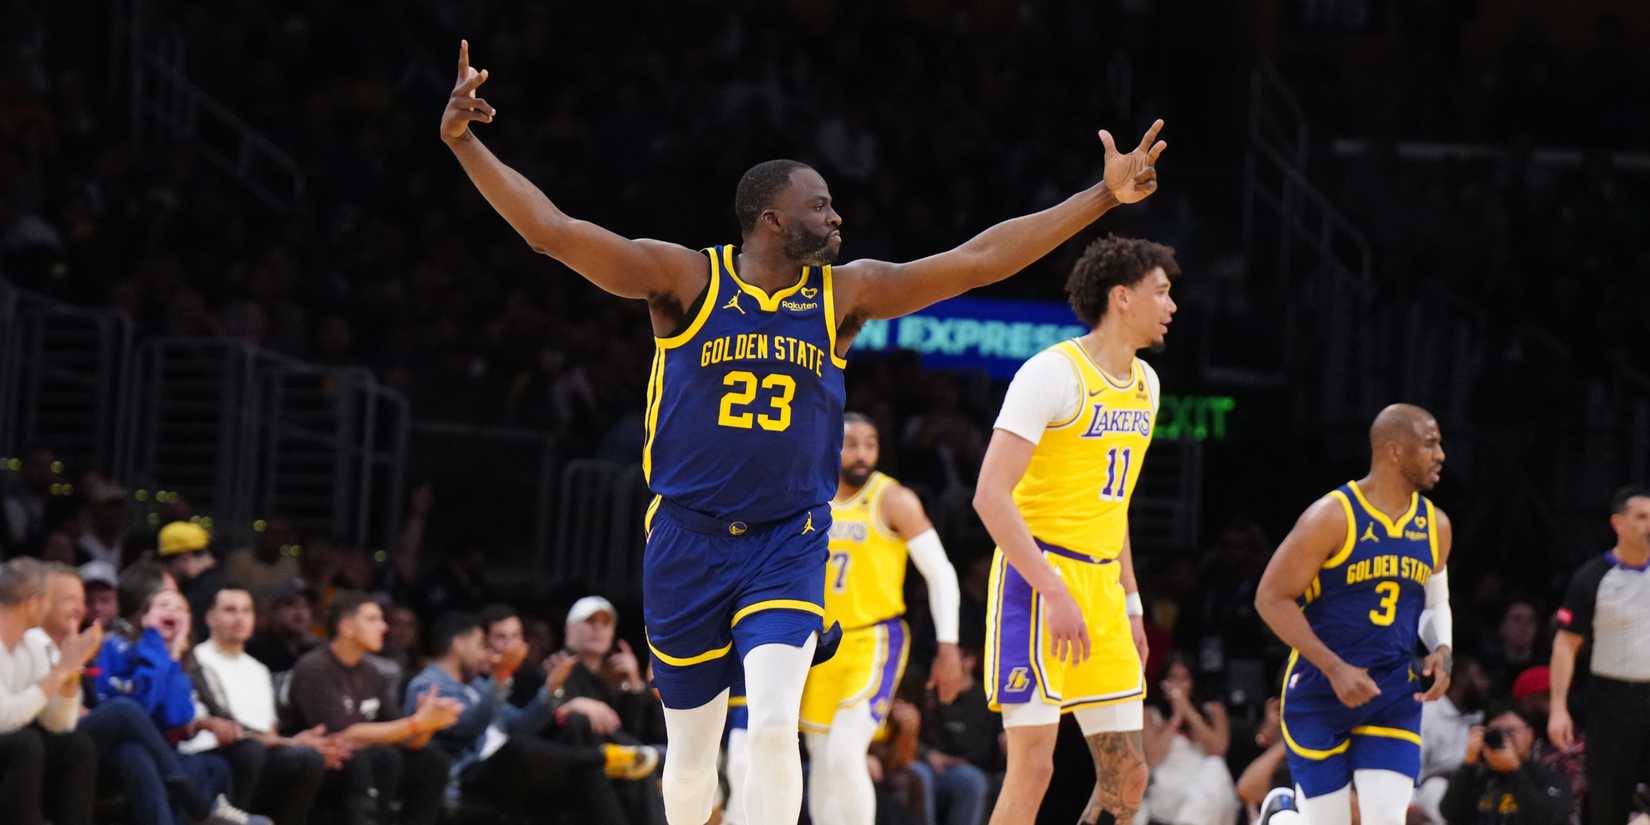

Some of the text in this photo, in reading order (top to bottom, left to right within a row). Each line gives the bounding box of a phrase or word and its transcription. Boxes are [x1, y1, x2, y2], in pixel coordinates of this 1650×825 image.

[782, 300, 818, 310] Rakuten
[701, 333, 825, 378] GOLDEN STATE
[718, 370, 796, 432] 23
[1081, 404, 1151, 438] LAKERS
[1101, 447, 1131, 501] 11
[832, 551, 850, 591] 7
[1346, 554, 1432, 585] GOLDEN STAT
[1368, 580, 1401, 627] 3
